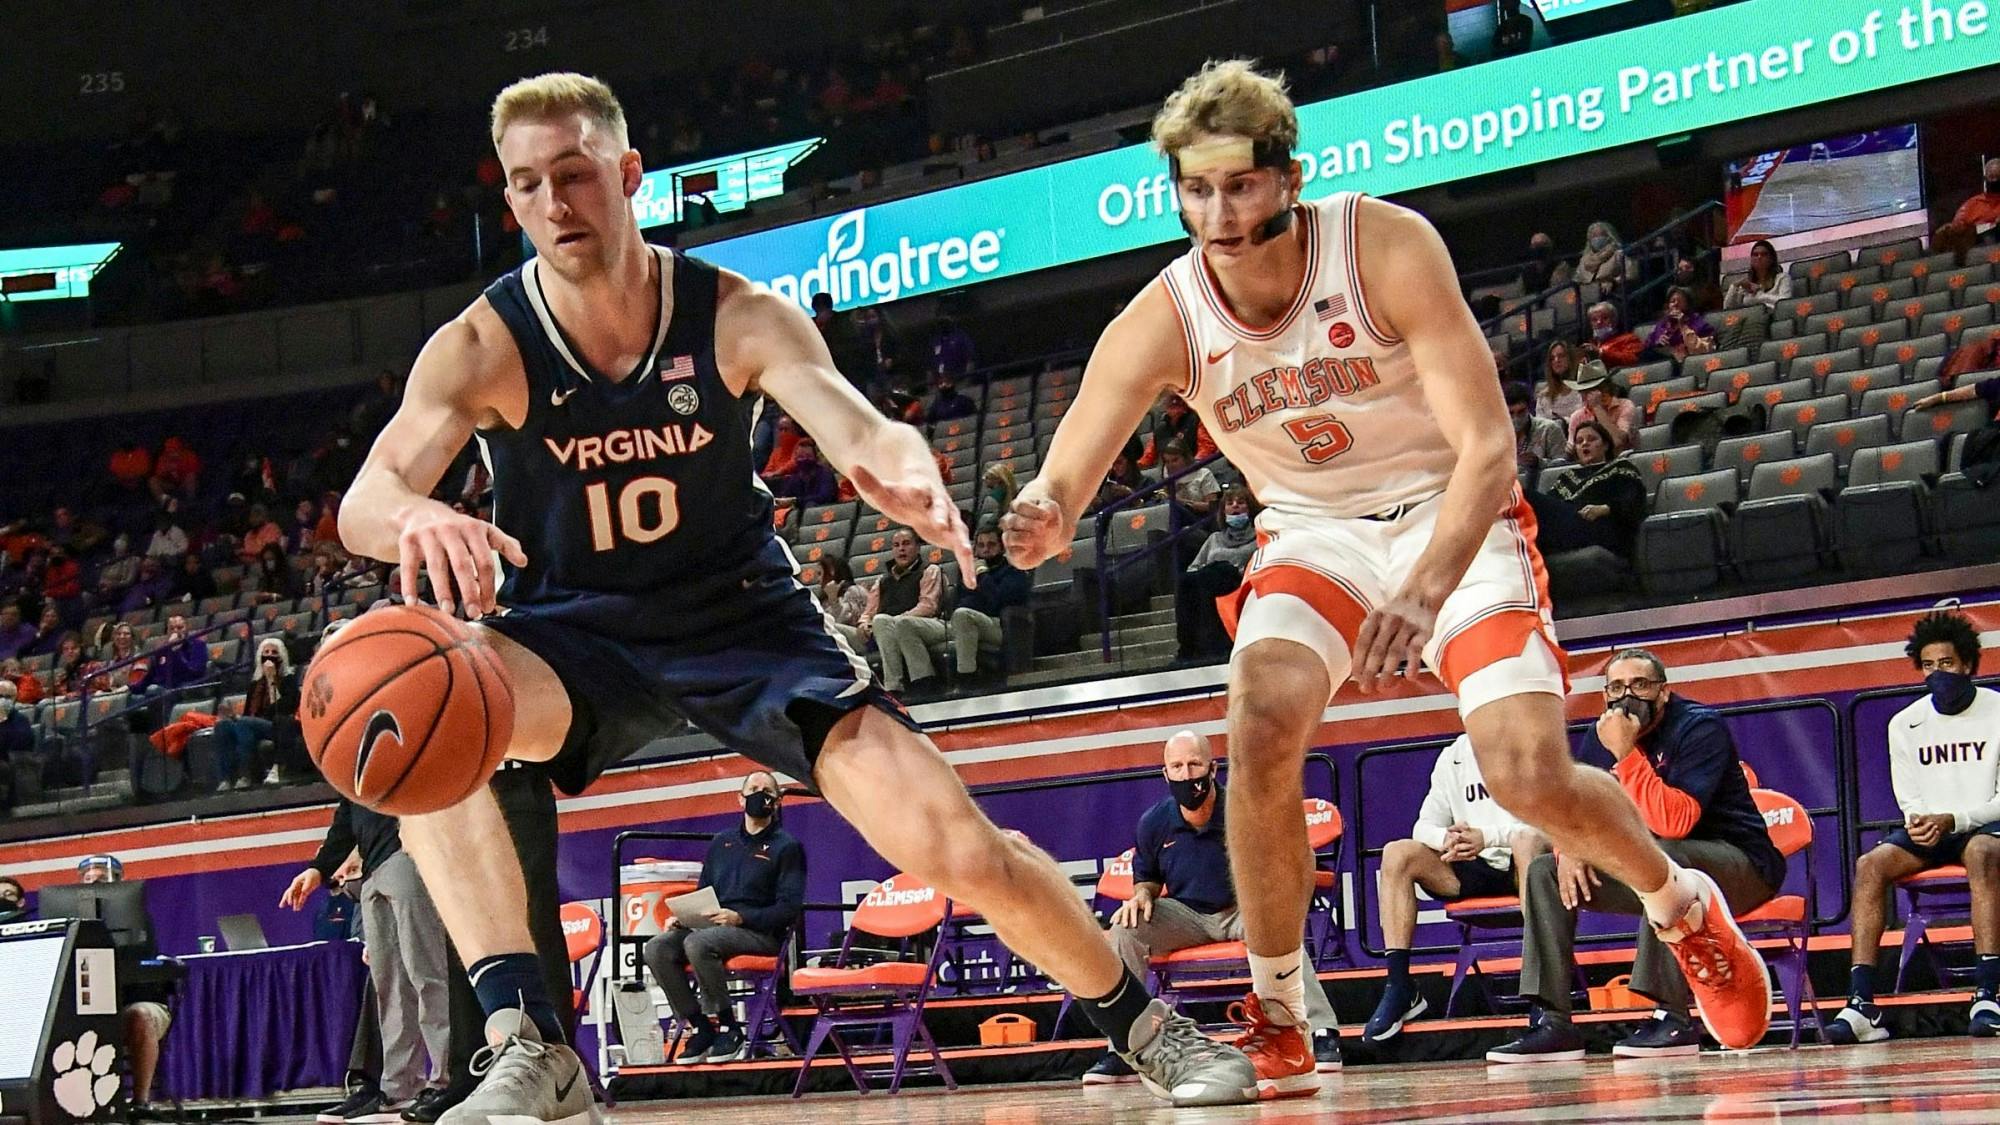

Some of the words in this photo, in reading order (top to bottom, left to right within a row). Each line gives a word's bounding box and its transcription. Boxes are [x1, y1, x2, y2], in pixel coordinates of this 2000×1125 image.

[505, 26, 549, 52] 234
[80, 72, 125, 93] 235
[1098, 173, 1179, 226] Offi
[1294, 139, 1372, 183] oan
[1384, 86, 1605, 165] Shopping
[1617, 38, 1813, 113] Partner
[1827, 9, 1883, 65] of
[1897, 0, 1989, 50] the
[751, 229, 1001, 309] ndingtree
[1213, 356, 1381, 433] CLEMSON
[543, 422, 715, 471] VRGINIA
[1282, 413, 1354, 464] 5
[585, 476, 679, 552] 10
[1918, 741, 1987, 766] UNITY
[627, 897, 645, 921] G
[866, 887, 935, 907] CLEMSON
